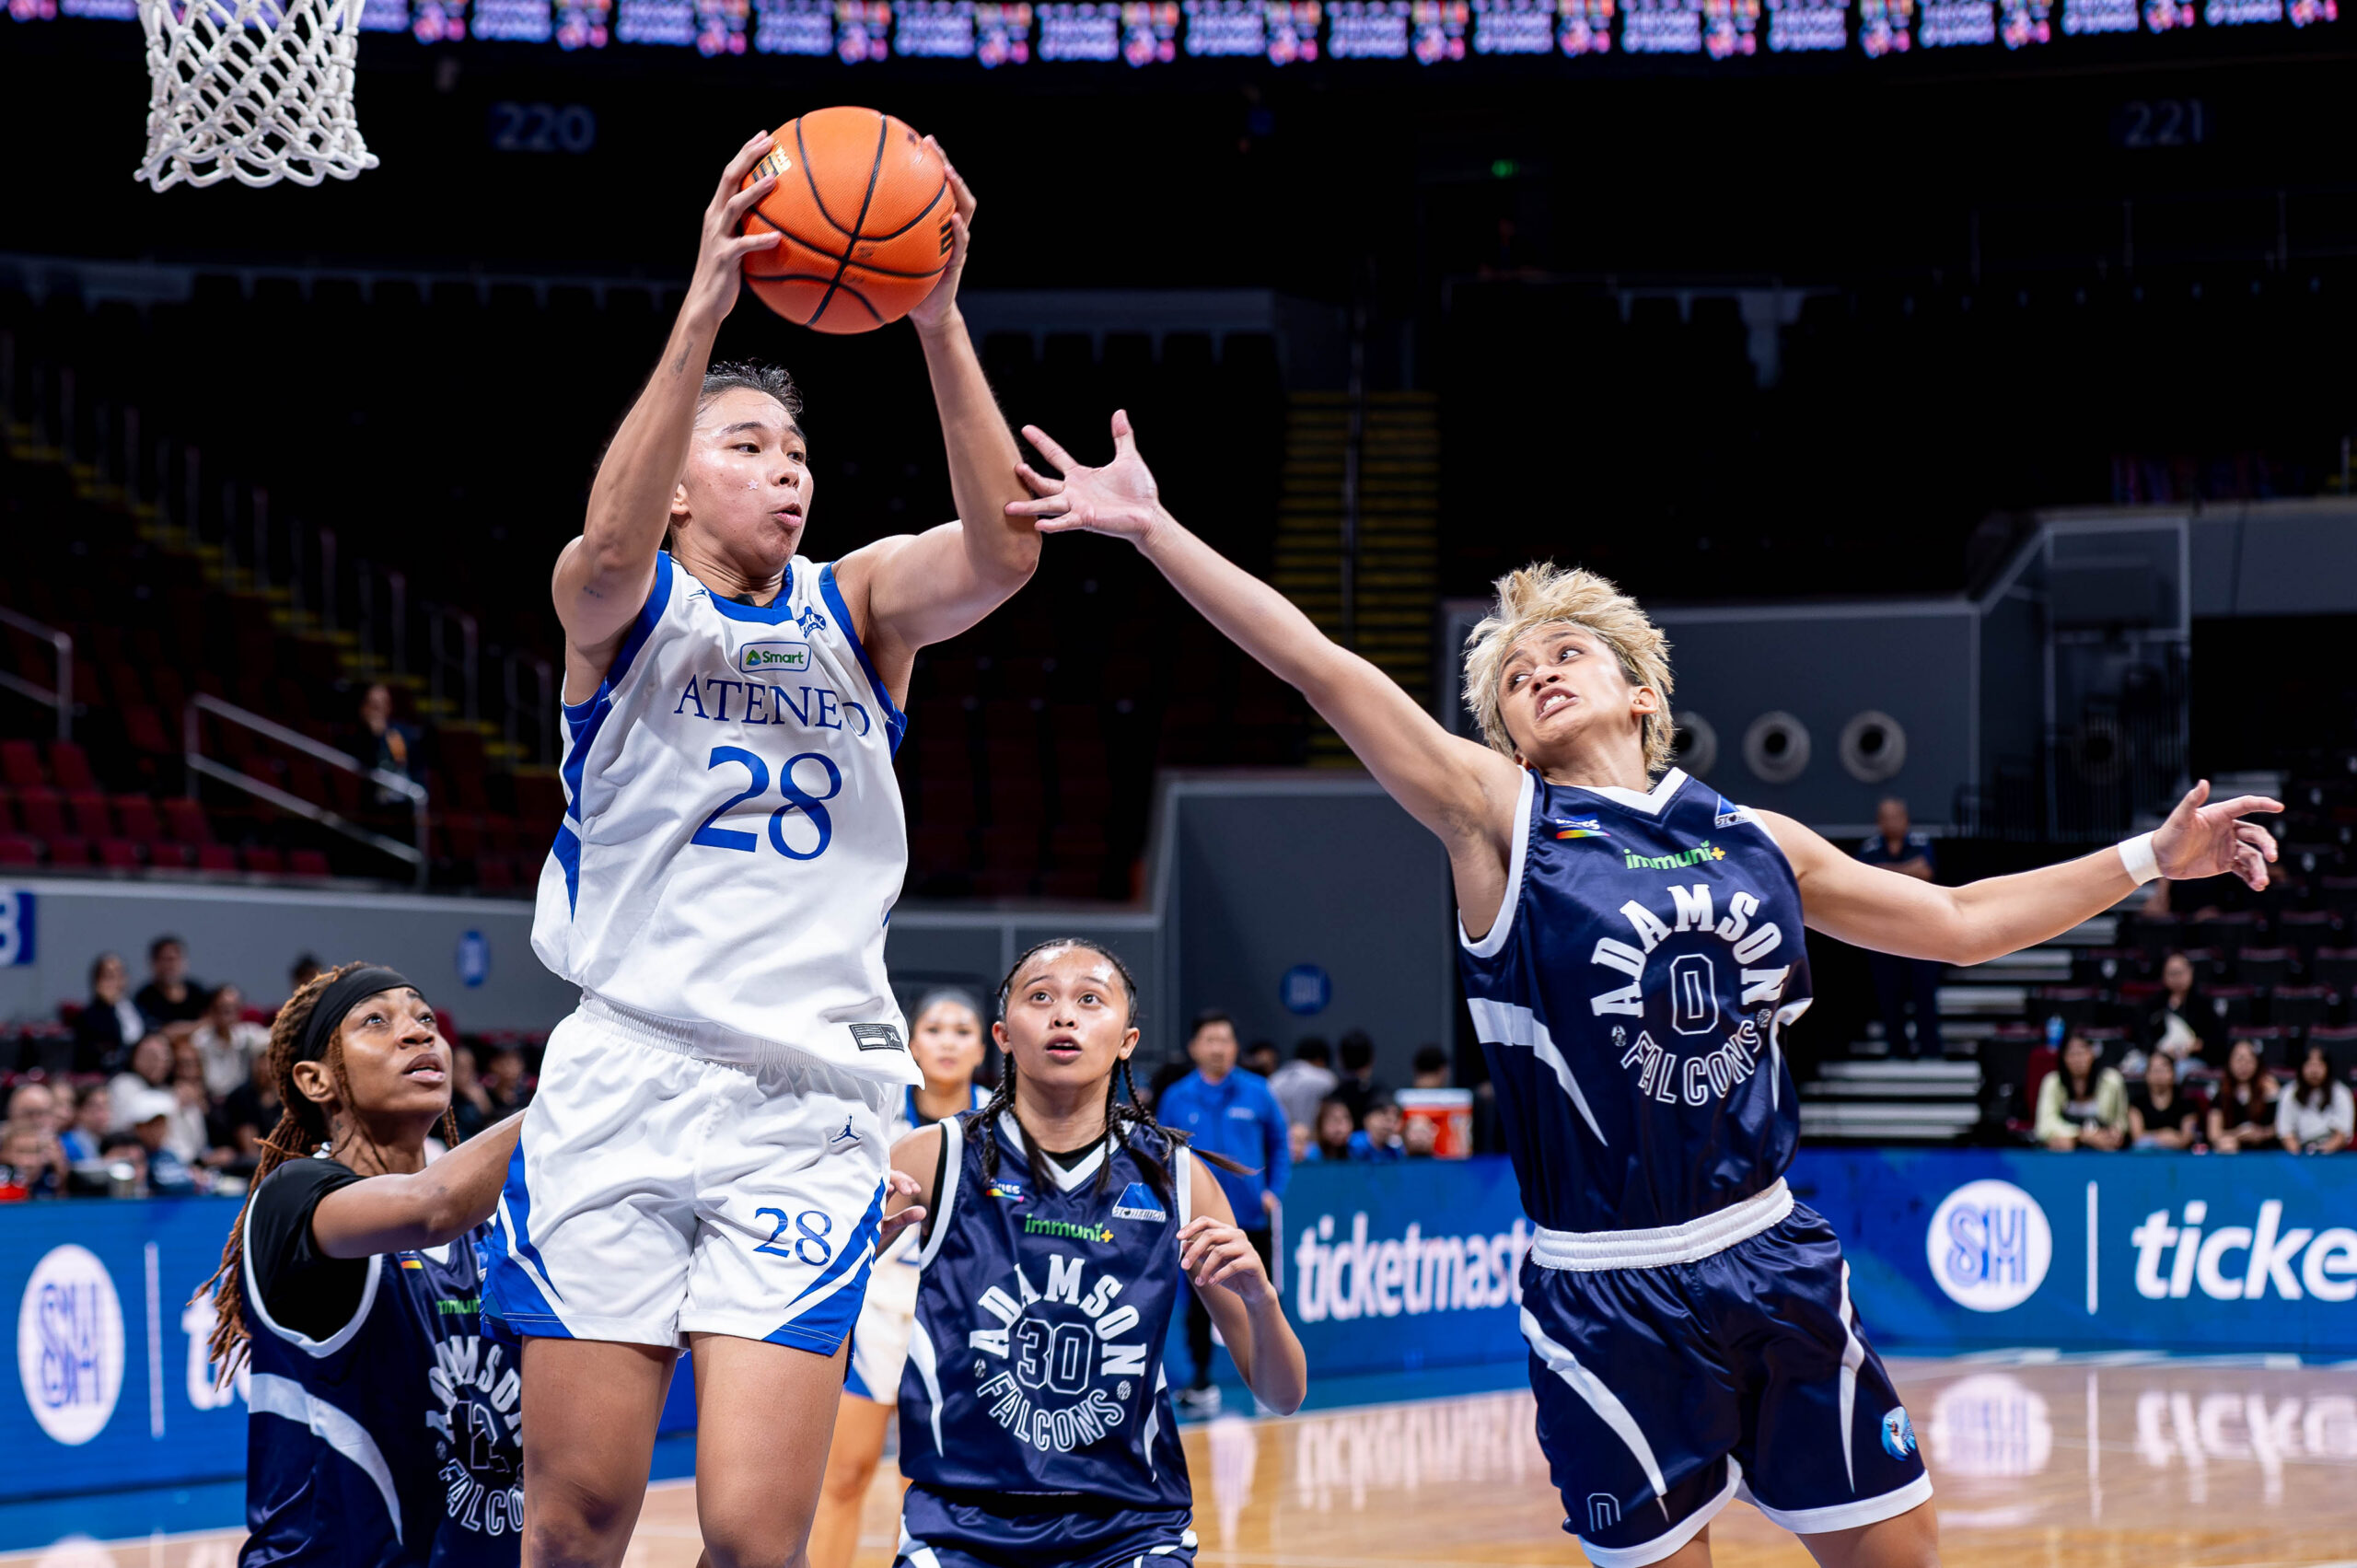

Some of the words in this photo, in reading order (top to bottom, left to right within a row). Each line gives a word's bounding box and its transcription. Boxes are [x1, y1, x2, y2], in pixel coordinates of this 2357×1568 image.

[494, 100, 596, 154] 220
[761, 650, 804, 665] Smart
[674, 675, 870, 737] ATENEO
[690, 745, 842, 861] 28
[1590, 883, 1791, 1018] ADAMSON
[1669, 953, 1719, 1036] 0
[1620, 1018, 1762, 1107] FALCONS
[752, 1206, 832, 1267] 28
[2131, 1200, 2357, 1302] ticke
[970, 1253, 1147, 1377] ADAMSON
[1016, 1317, 1094, 1396] 30
[976, 1369, 1125, 1453] FALCONS
